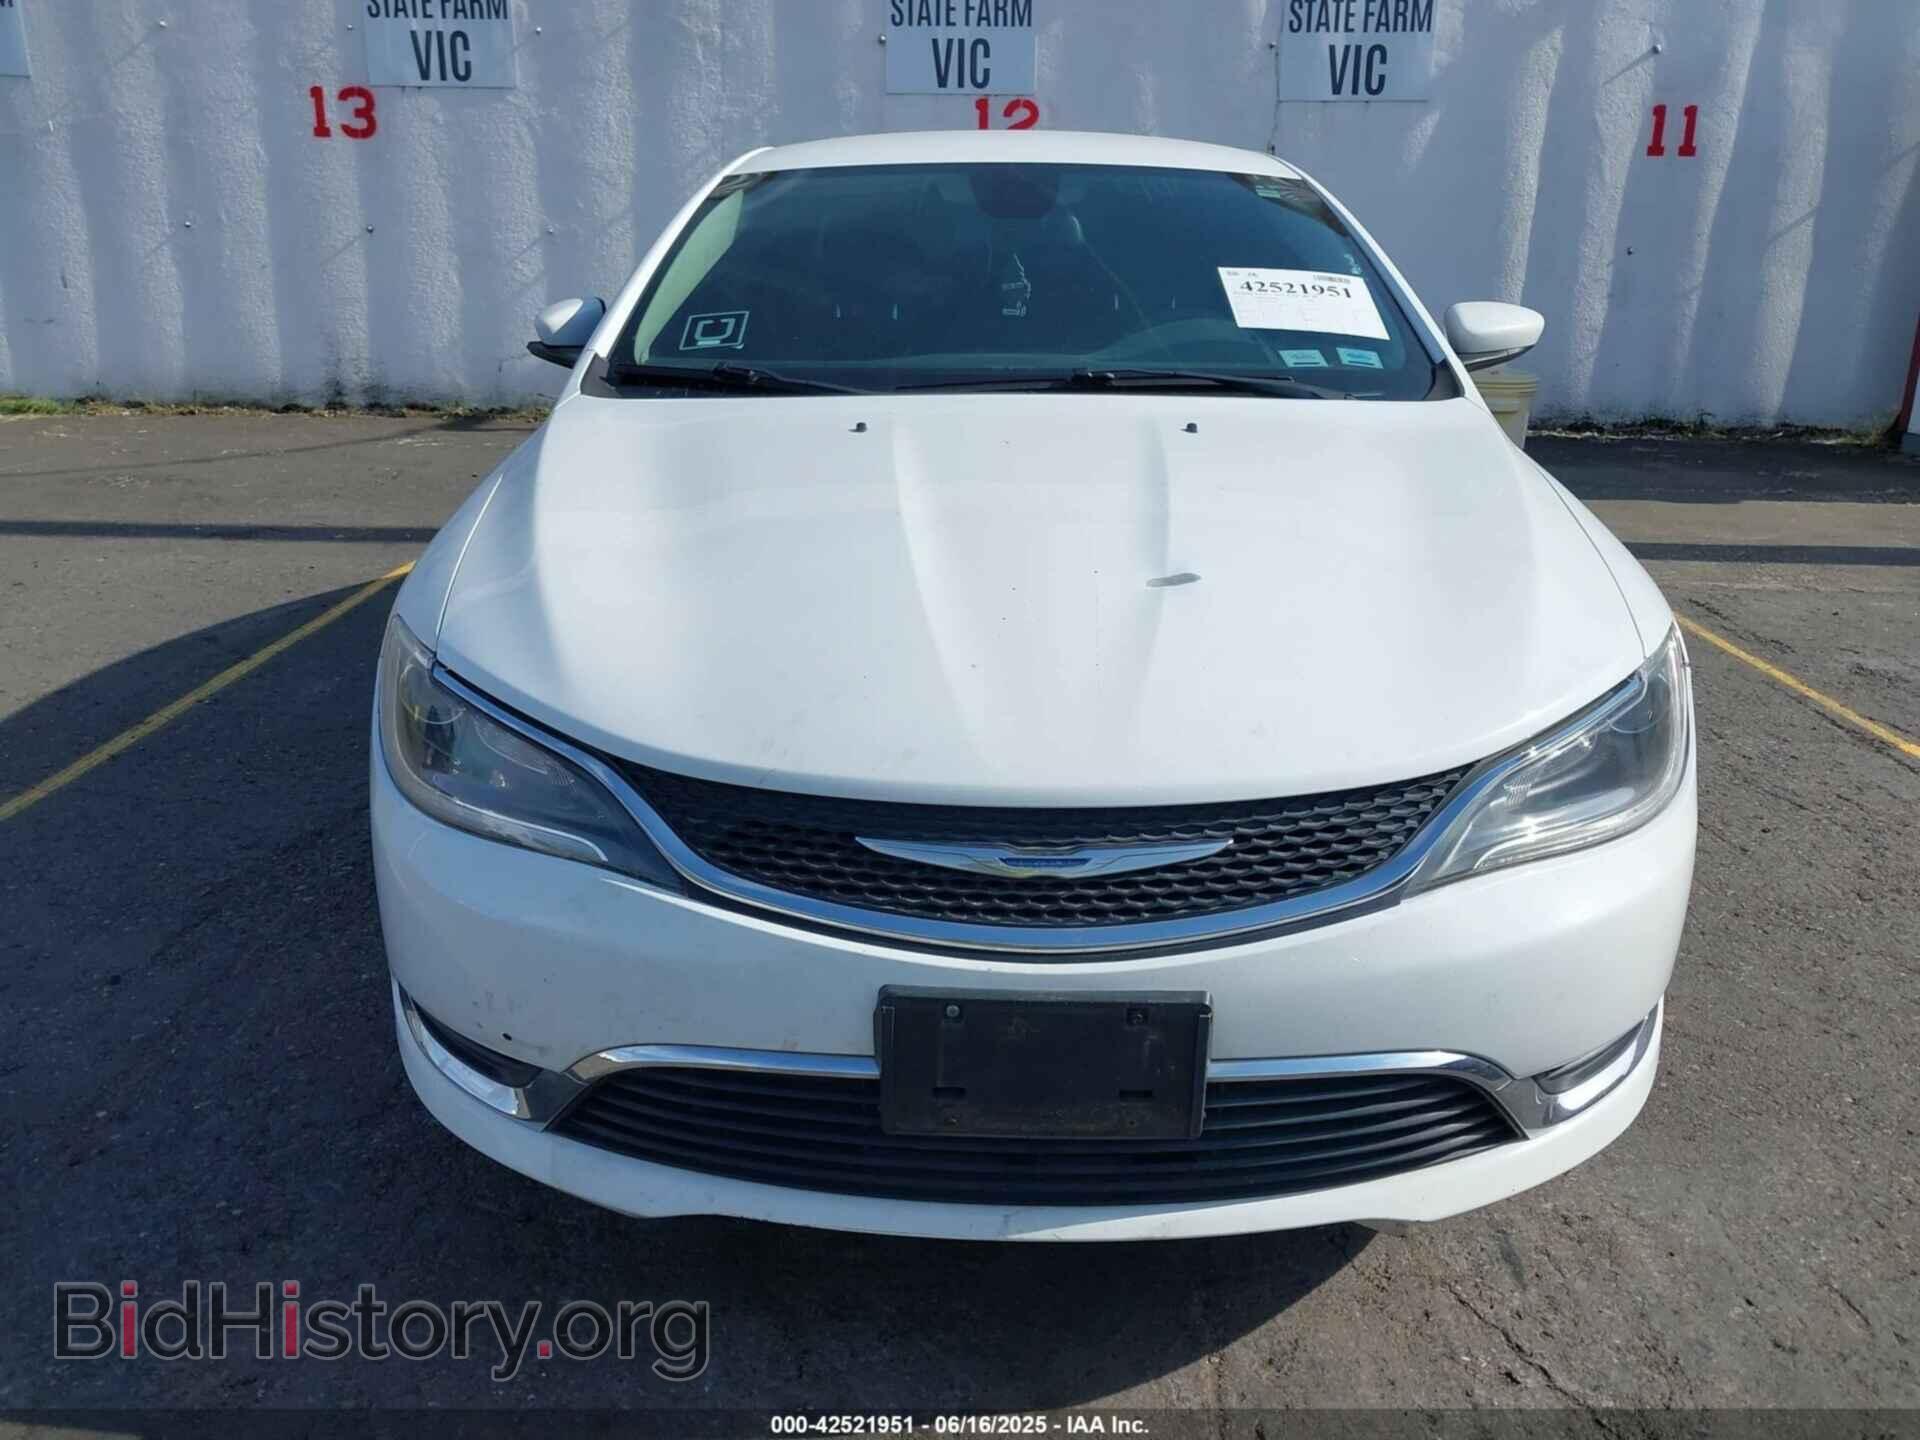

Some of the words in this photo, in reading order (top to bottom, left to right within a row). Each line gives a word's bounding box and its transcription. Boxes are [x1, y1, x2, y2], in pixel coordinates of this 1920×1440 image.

[891, 0, 957, 27] STATE
[964, 0, 1032, 27] FARM
[1289, 0, 1355, 33] STATE
[1363, 0, 1433, 33] FARM
[410, 30, 472, 82] VIC
[932, 38, 991, 89] VIC
[1329, 44, 1388, 96] VIC
[310, 85, 377, 139] 13
[975, 96, 1040, 130] 12
[1647, 104, 1698, 157] 11
[1240, 279, 1352, 299] 42521951
